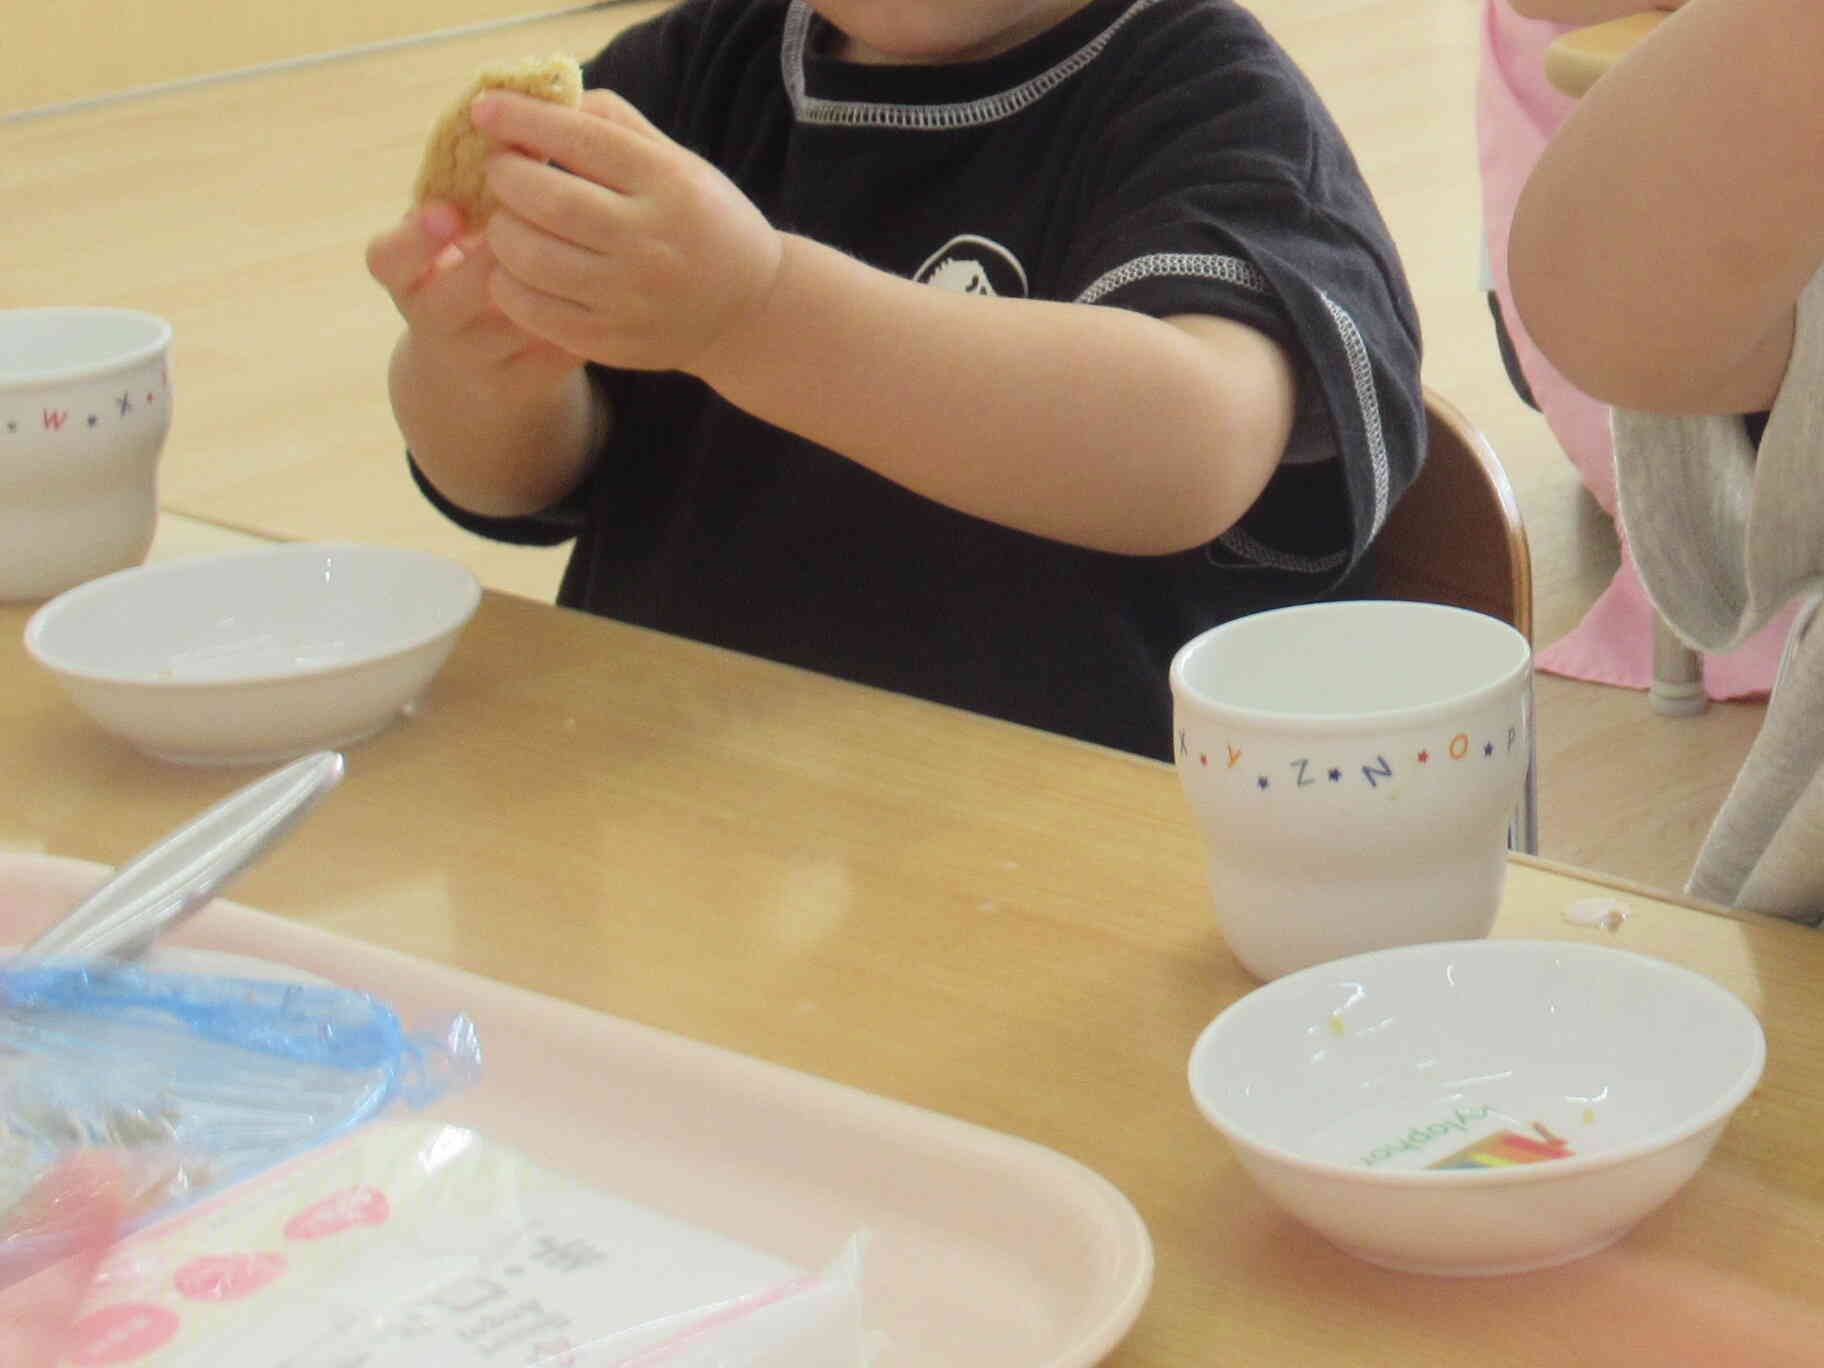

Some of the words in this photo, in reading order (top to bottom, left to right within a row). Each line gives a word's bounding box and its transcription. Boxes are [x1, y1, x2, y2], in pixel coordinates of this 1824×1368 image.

[1226, 742, 1243, 769] Y
[1289, 758, 1317, 789] Z
[1449, 733, 1470, 760] O
